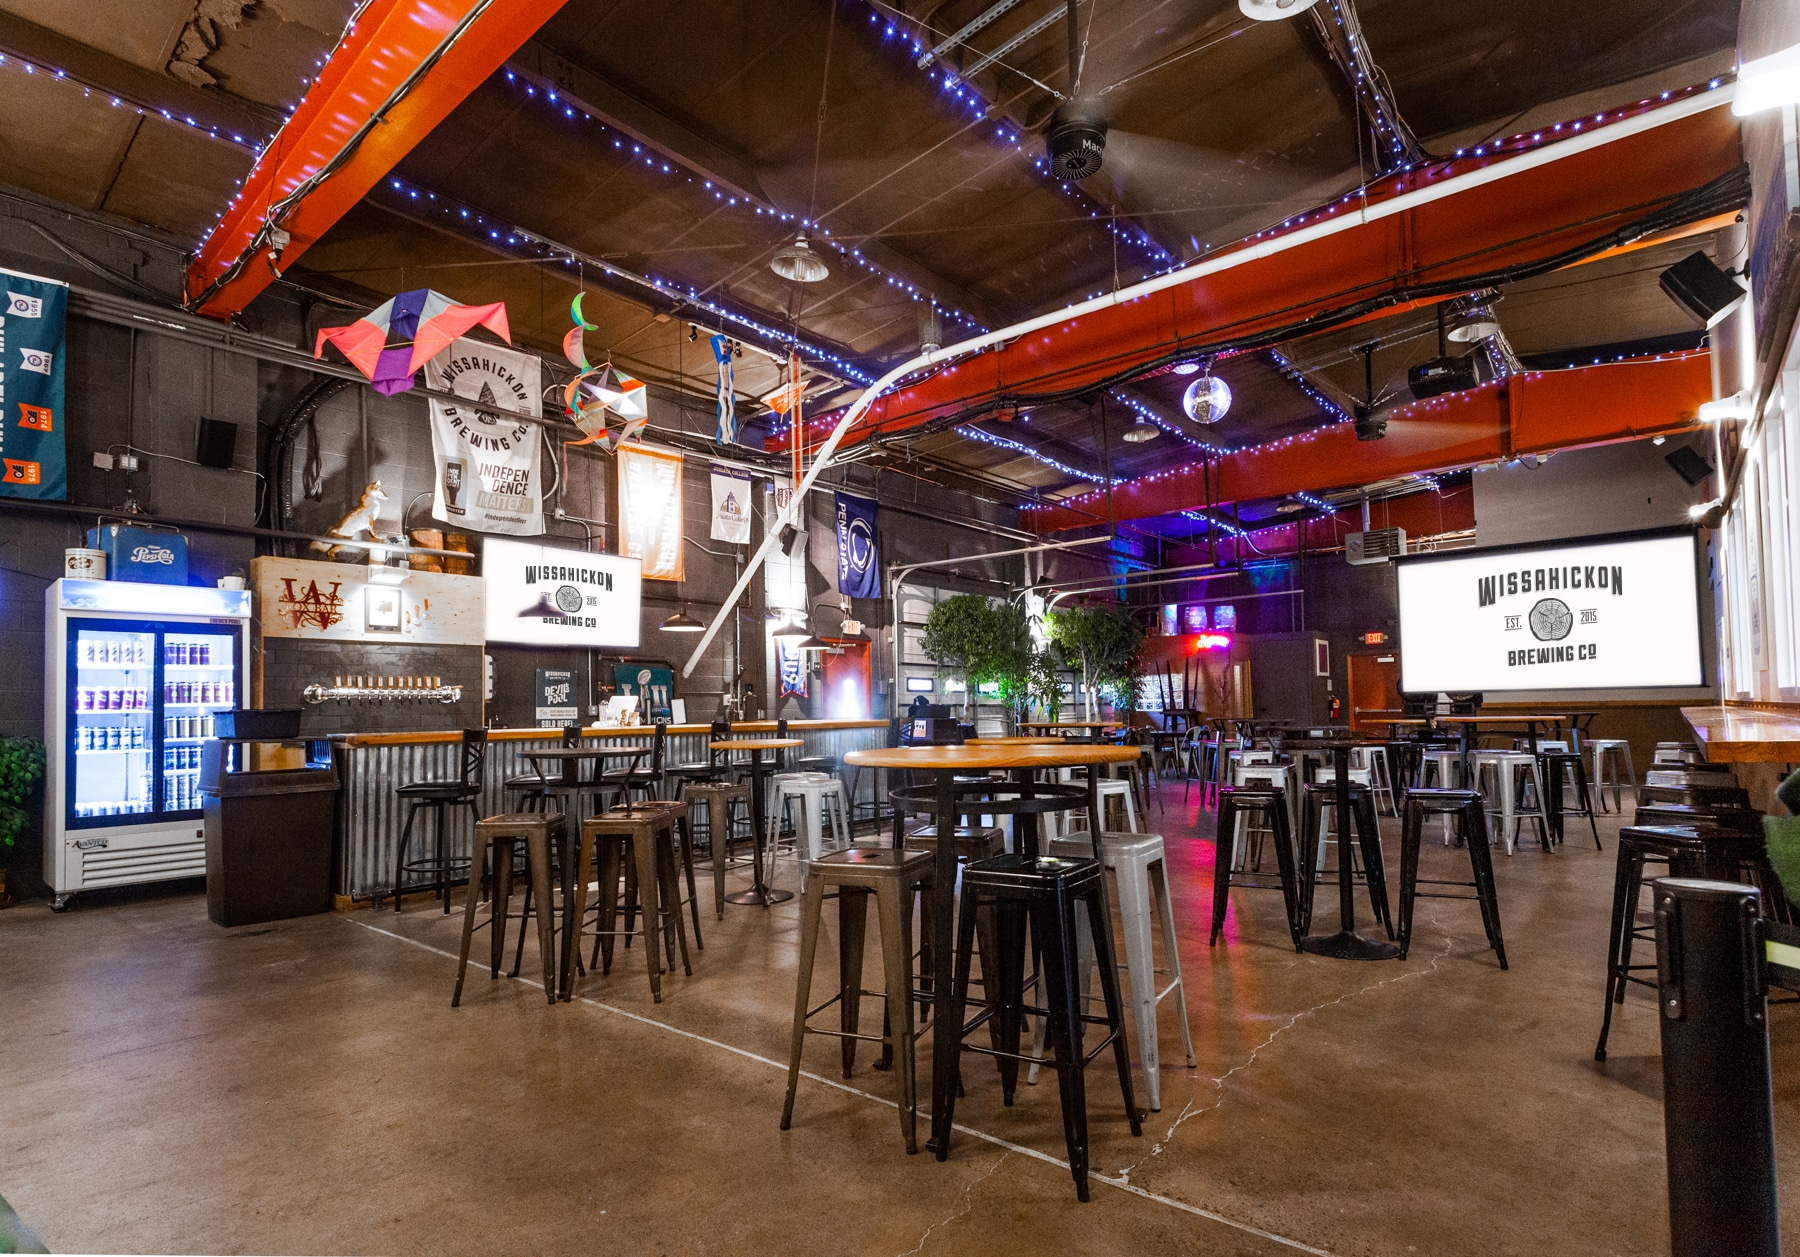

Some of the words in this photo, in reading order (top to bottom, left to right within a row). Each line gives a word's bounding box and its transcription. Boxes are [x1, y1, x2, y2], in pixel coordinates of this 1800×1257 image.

[31, 300, 39, 316] 1955
[441, 357, 528, 401] WISSAHICKON
[40, 410, 48, 429] 1974
[444, 407, 510, 451] BREWING
[28, 464, 36, 482] 1975
[479, 463, 530, 482] INDEPEN
[492, 479, 528, 496] DENCE
[478, 491, 527, 512] MATTERS
[526, 566, 613, 592] WISSAHICKON
[1478, 566, 1623, 607] WISSAHICKON
[1505, 617, 1522, 628] EST.
[1580, 610, 1597, 622] 2015
[1368, 633, 1382, 643] EXIT
[1508, 645, 1574, 666] BREWING
[547, 692, 568, 705] POOL
